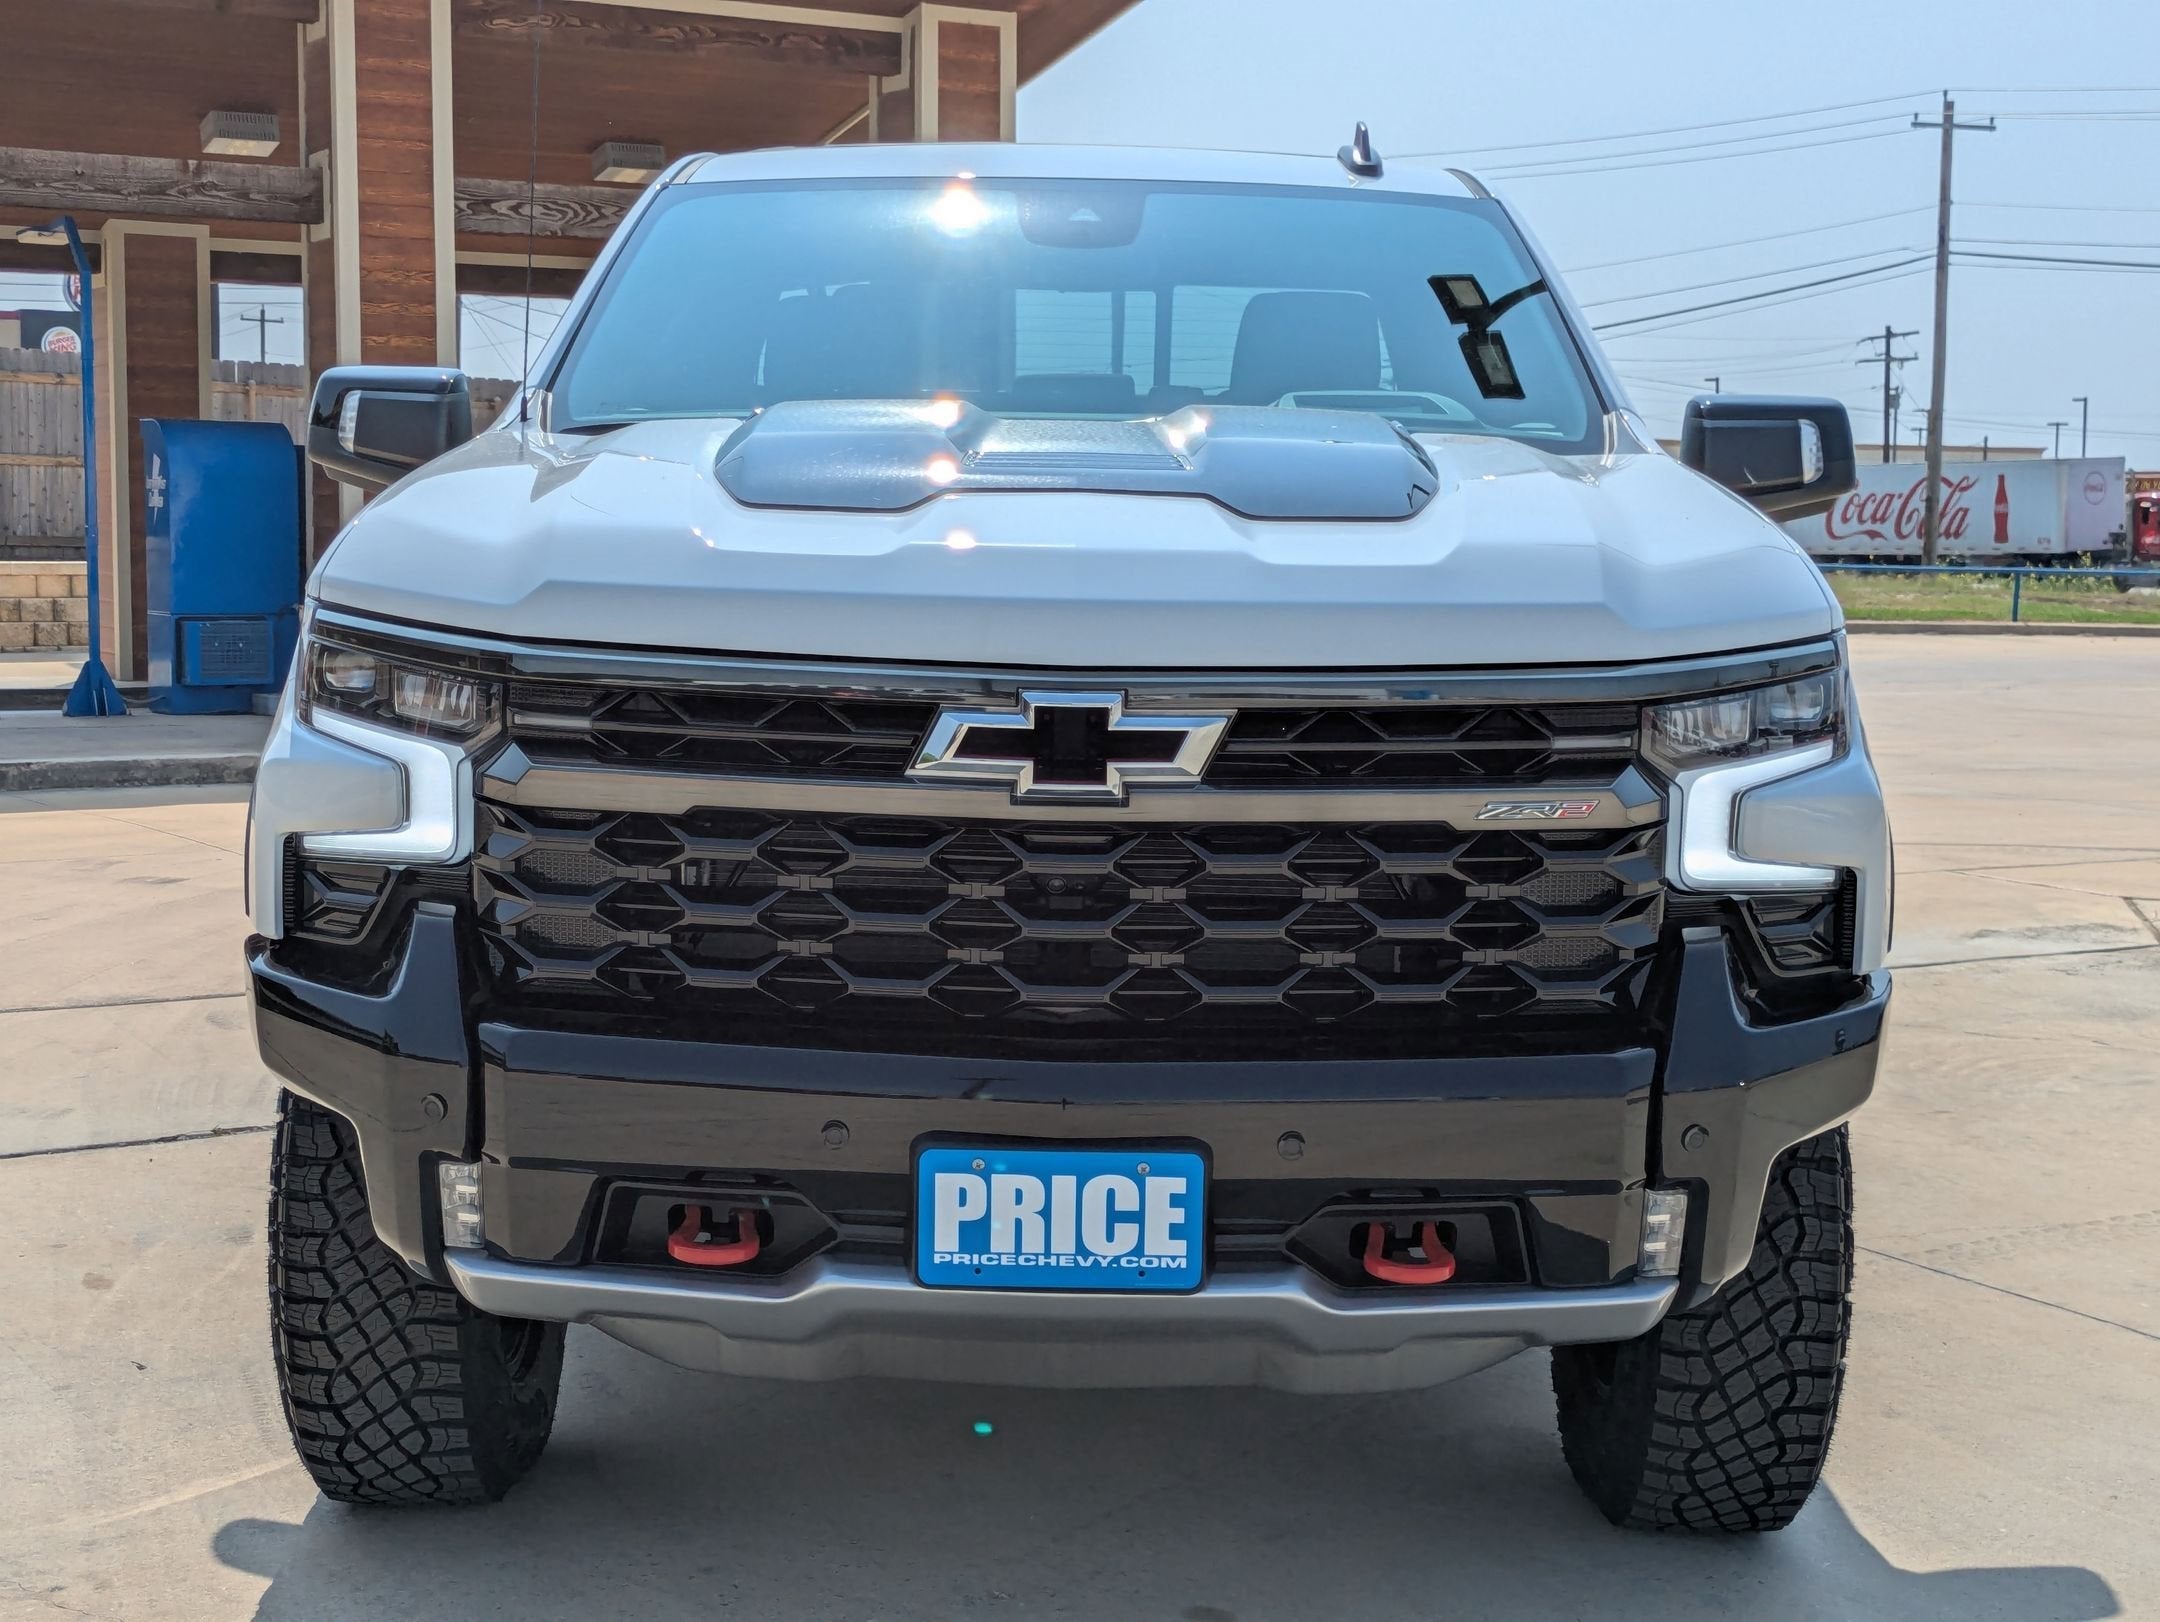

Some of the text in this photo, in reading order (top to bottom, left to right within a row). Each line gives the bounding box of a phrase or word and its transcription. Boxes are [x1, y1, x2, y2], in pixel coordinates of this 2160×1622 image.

[1474, 800, 1600, 820] ZR2
[934, 1172, 1187, 1257] PRICE
[933, 1253, 1187, 1269] PRICECHEVY.COM
